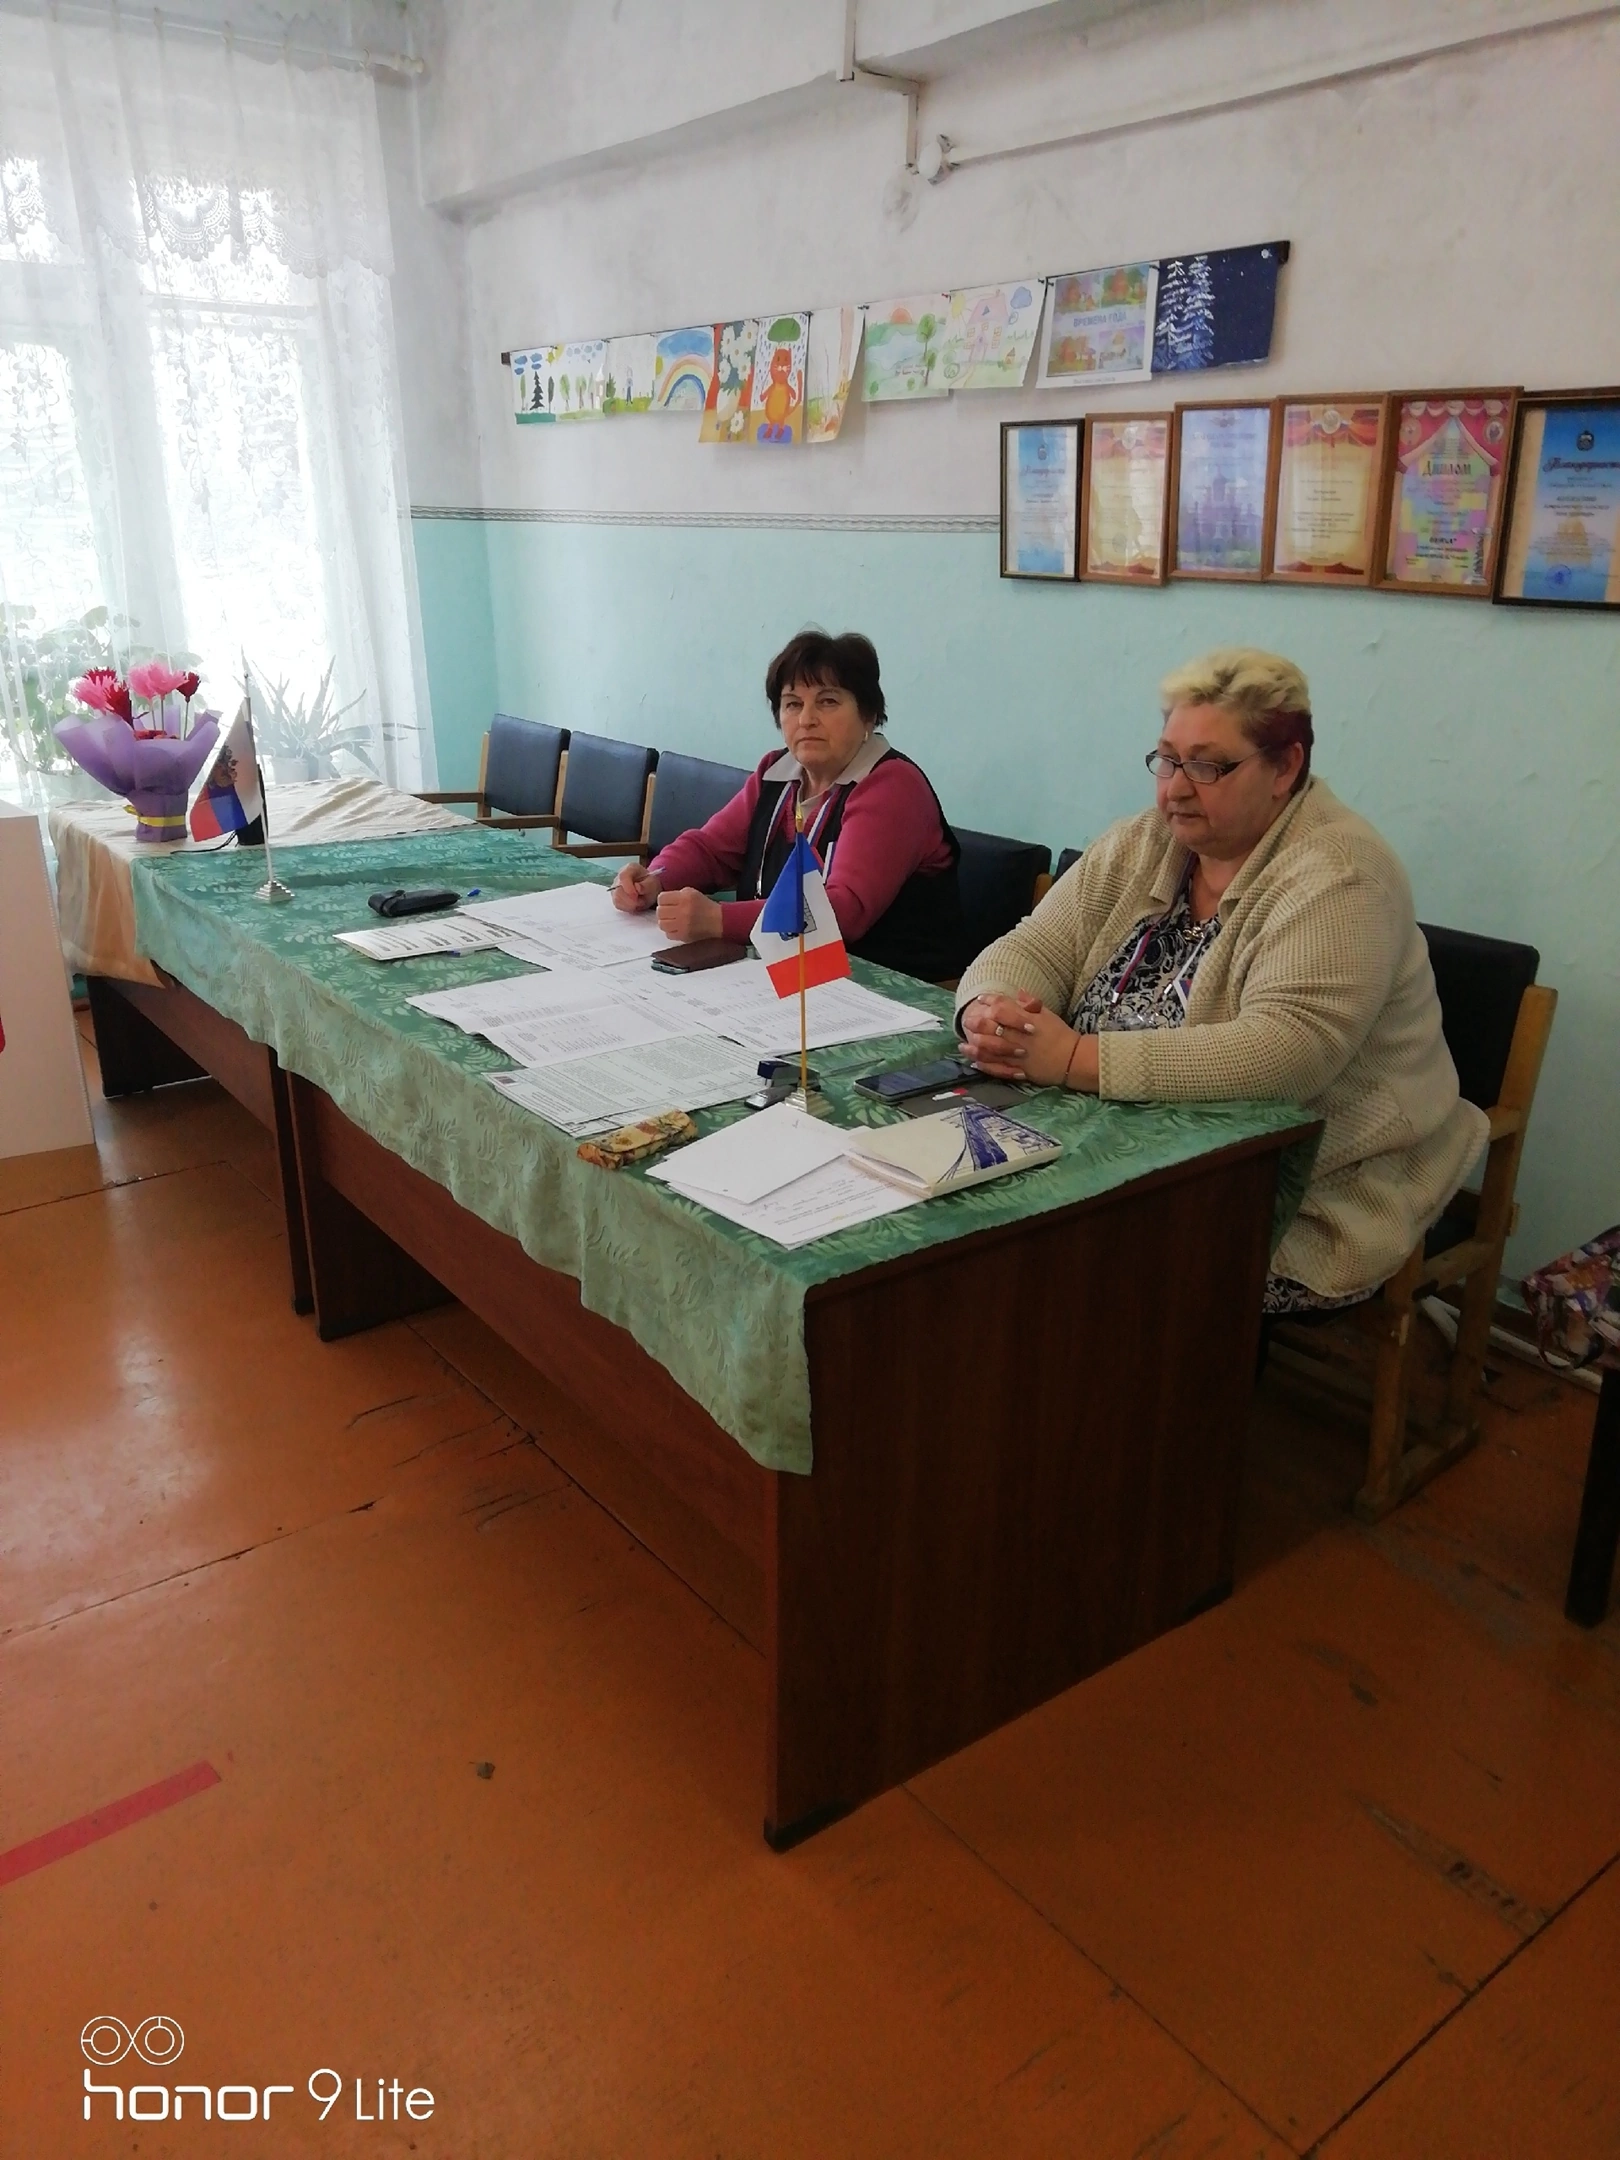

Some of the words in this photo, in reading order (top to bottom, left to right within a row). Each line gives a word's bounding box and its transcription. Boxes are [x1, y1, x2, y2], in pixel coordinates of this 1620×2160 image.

[1073, 314, 1107, 328] ВРЕМЕНА
[1108, 311, 1127, 322] ГОДА
[1422, 460, 1472, 476] Диплом
